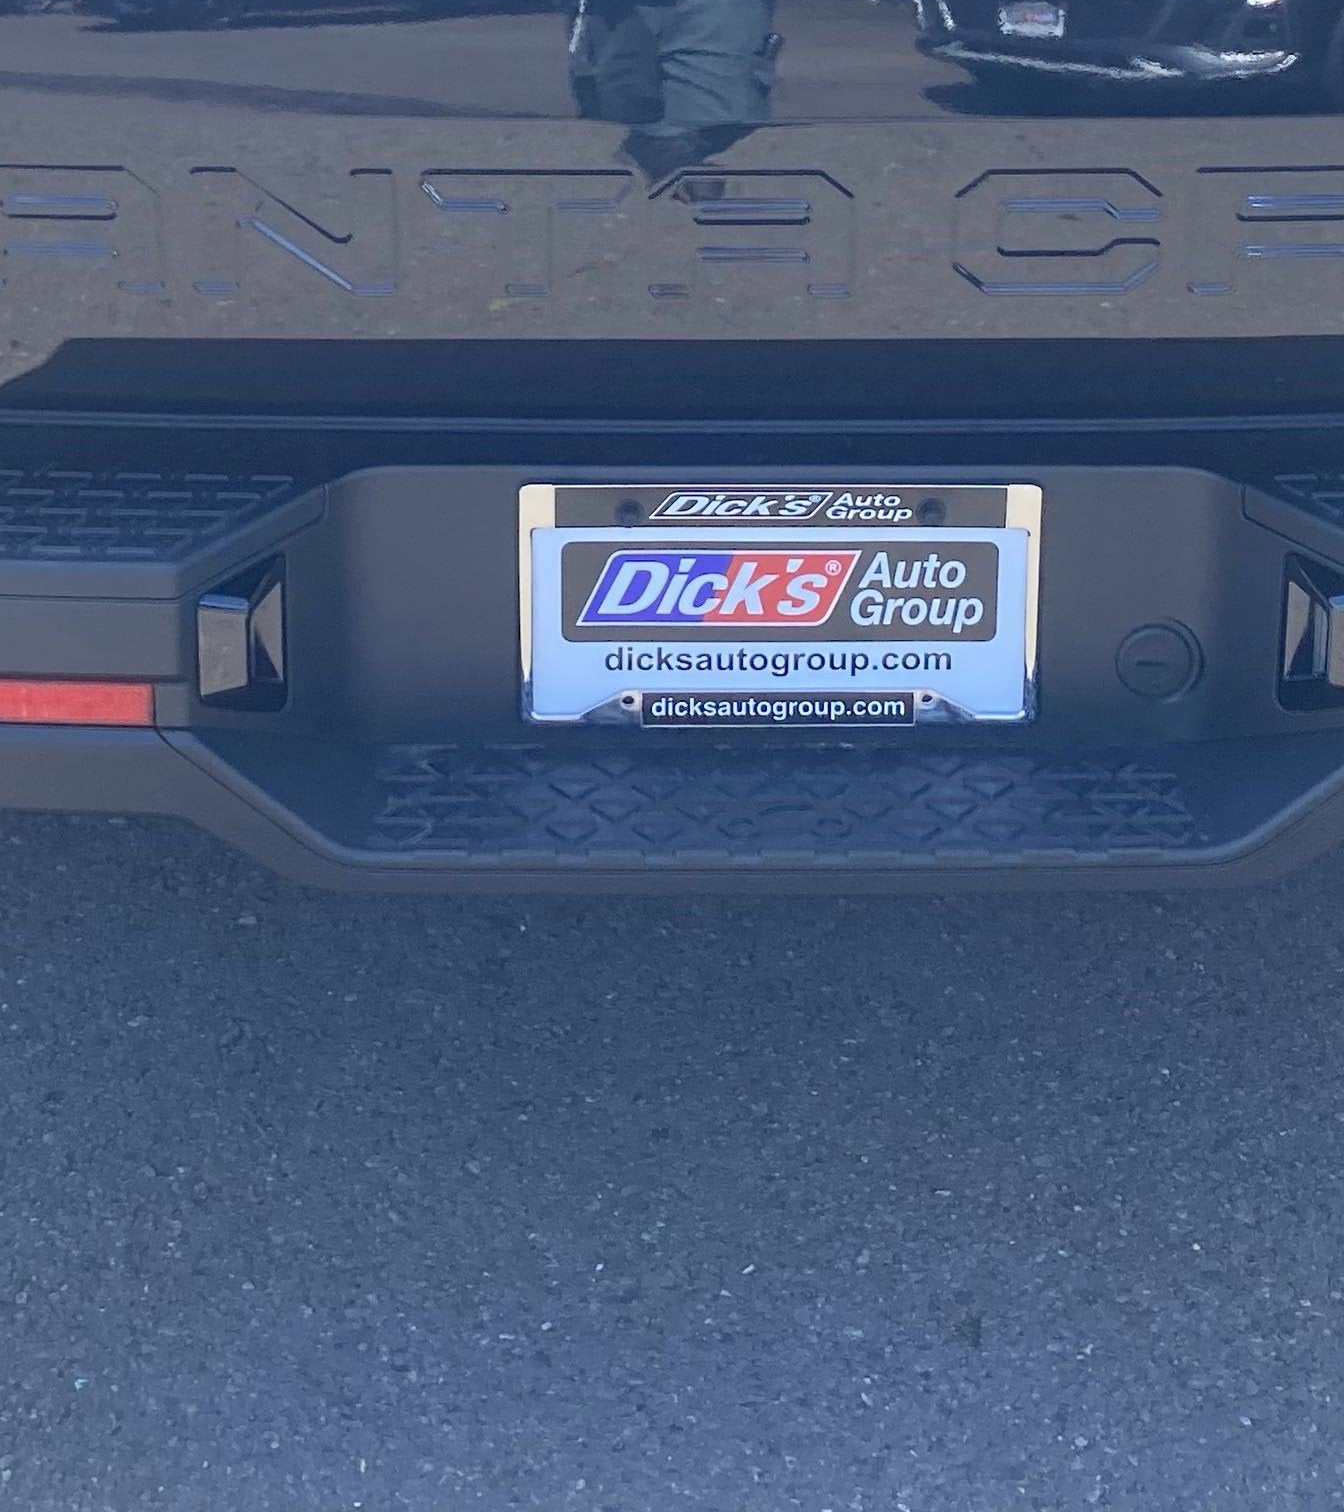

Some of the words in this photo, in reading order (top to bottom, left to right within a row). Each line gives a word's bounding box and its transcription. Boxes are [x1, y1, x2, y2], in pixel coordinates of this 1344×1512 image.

[834, 492, 901, 507] Auto
[824, 506, 913, 522] Group
[858, 551, 967, 589] Auto
[849, 589, 985, 633] Group
[604, 646, 953, 676] dicksautogroup.com
[650, 697, 906, 721] dicksautogroup.com
